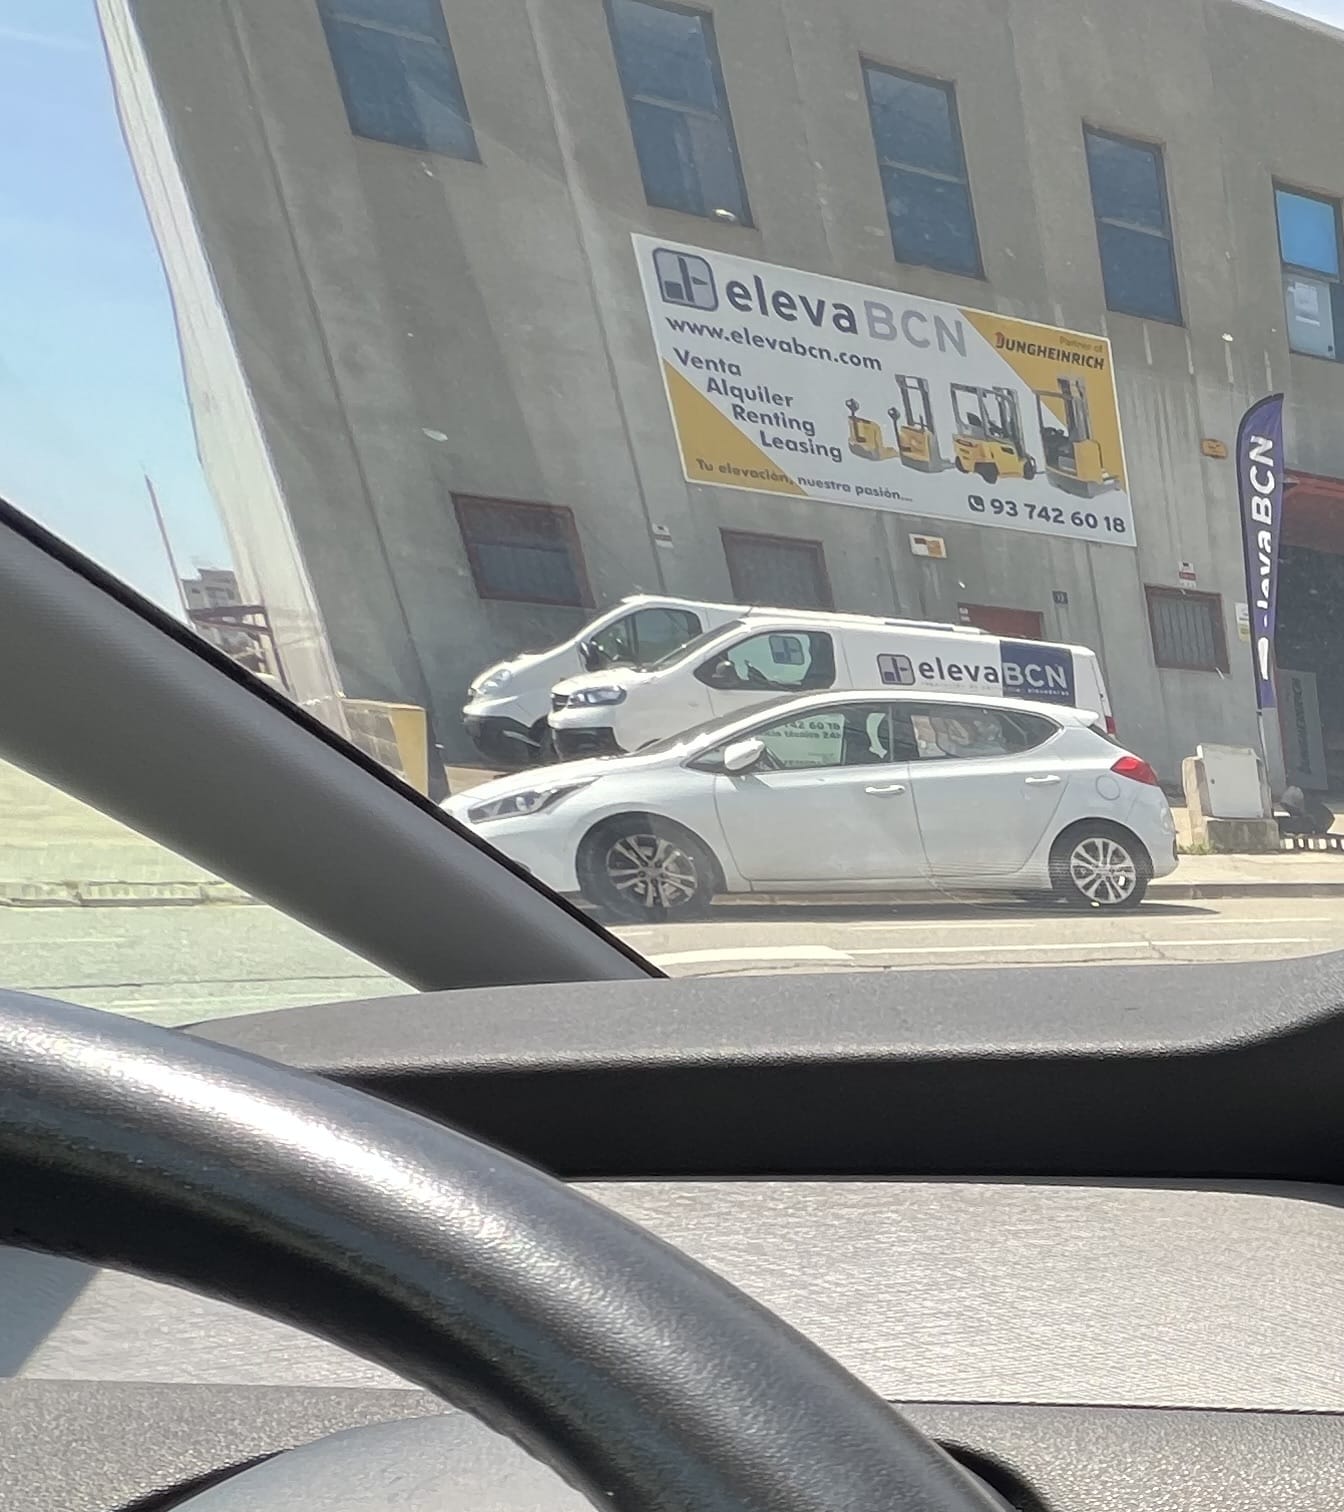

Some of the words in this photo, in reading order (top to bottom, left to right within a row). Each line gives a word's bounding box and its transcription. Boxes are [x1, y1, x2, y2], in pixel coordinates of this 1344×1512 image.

[725, 274, 967, 358] elevaBCN
[665, 316, 882, 371] www.elevabcn.com
[994, 331, 1105, 370] JUNGHEINRICH
[673, 347, 742, 376] Venta
[706, 377, 794, 407] Alquiler
[731, 403, 815, 436] Renting
[760, 430, 843, 463] Leasing
[696, 458, 714, 472] Tu
[797, 475, 851, 493] nuestra
[991, 498, 1018, 517] 93
[1024, 503, 1065, 525] 742
[1071, 511, 1098, 529] 60
[1104, 515, 1126, 533] 18
[918, 656, 1068, 689] elevaBCN
